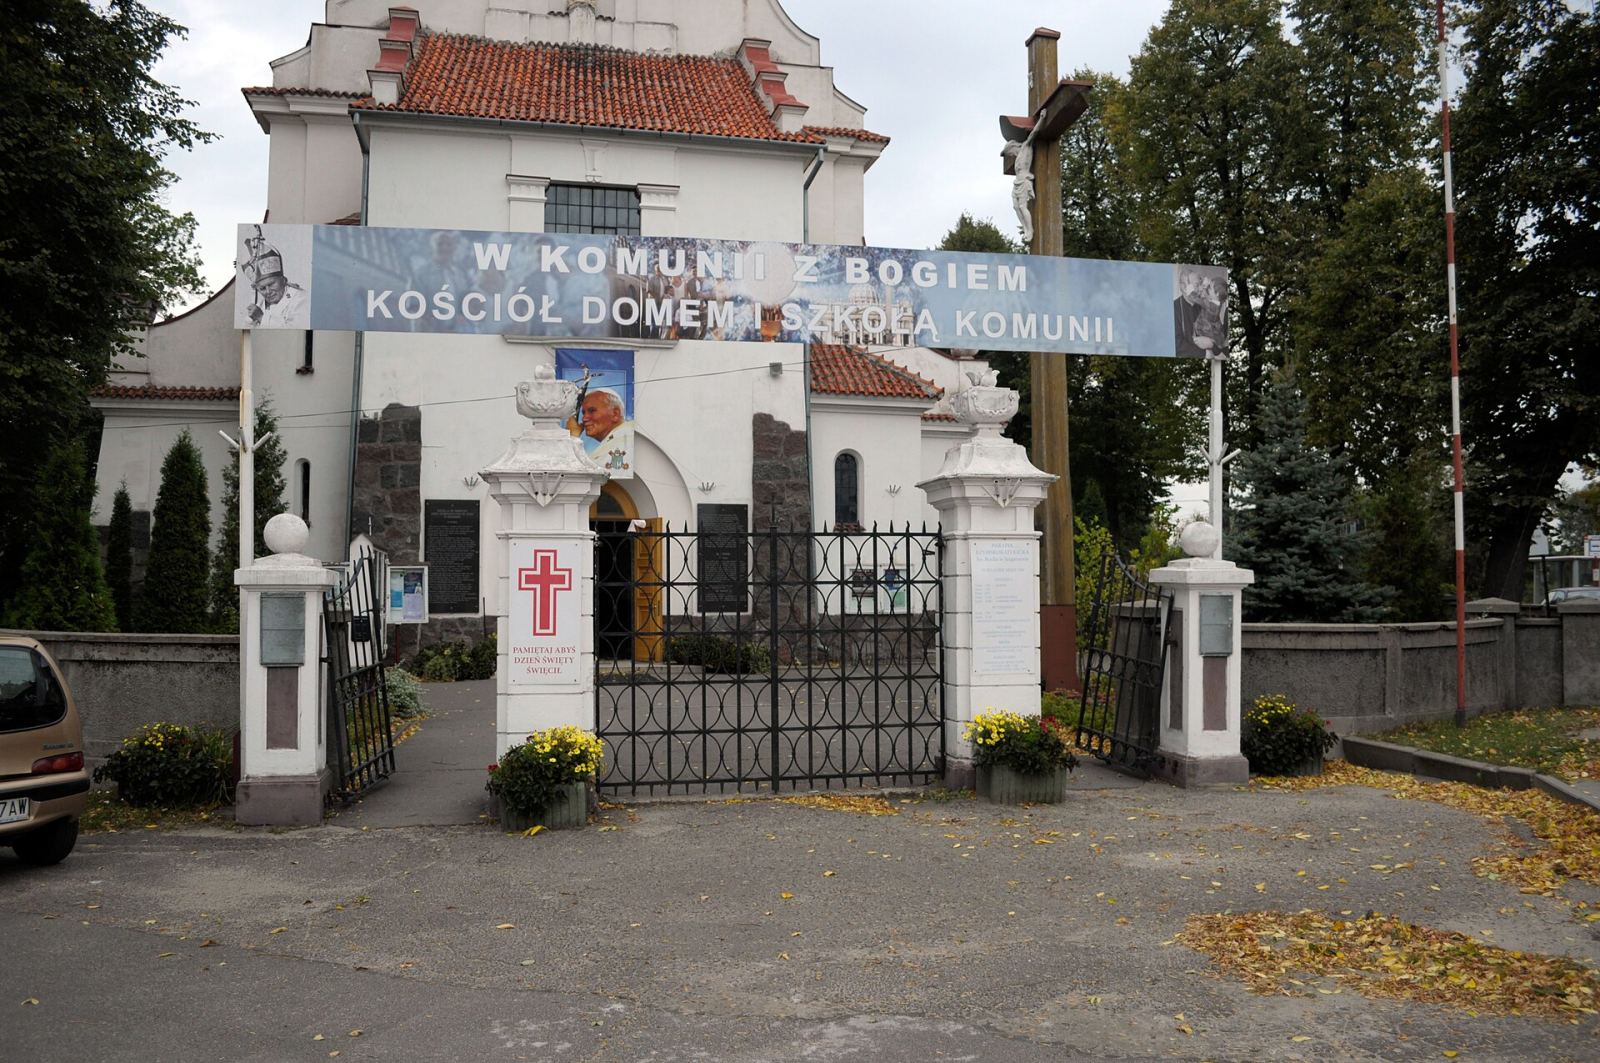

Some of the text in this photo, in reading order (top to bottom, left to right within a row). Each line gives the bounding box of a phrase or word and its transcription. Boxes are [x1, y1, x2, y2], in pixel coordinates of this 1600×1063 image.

[473, 242, 1027, 292] W KOMUNII Z BOGIEM
[366, 284, 1114, 343] KOŚCIÓŁ DOMEM I SZKOŁĄ KOMUNII
[513, 646, 576, 655] PAMIĘTAJ ABYŚ
[514, 656, 574, 665] DZIEŃ ŚWIĘTY
